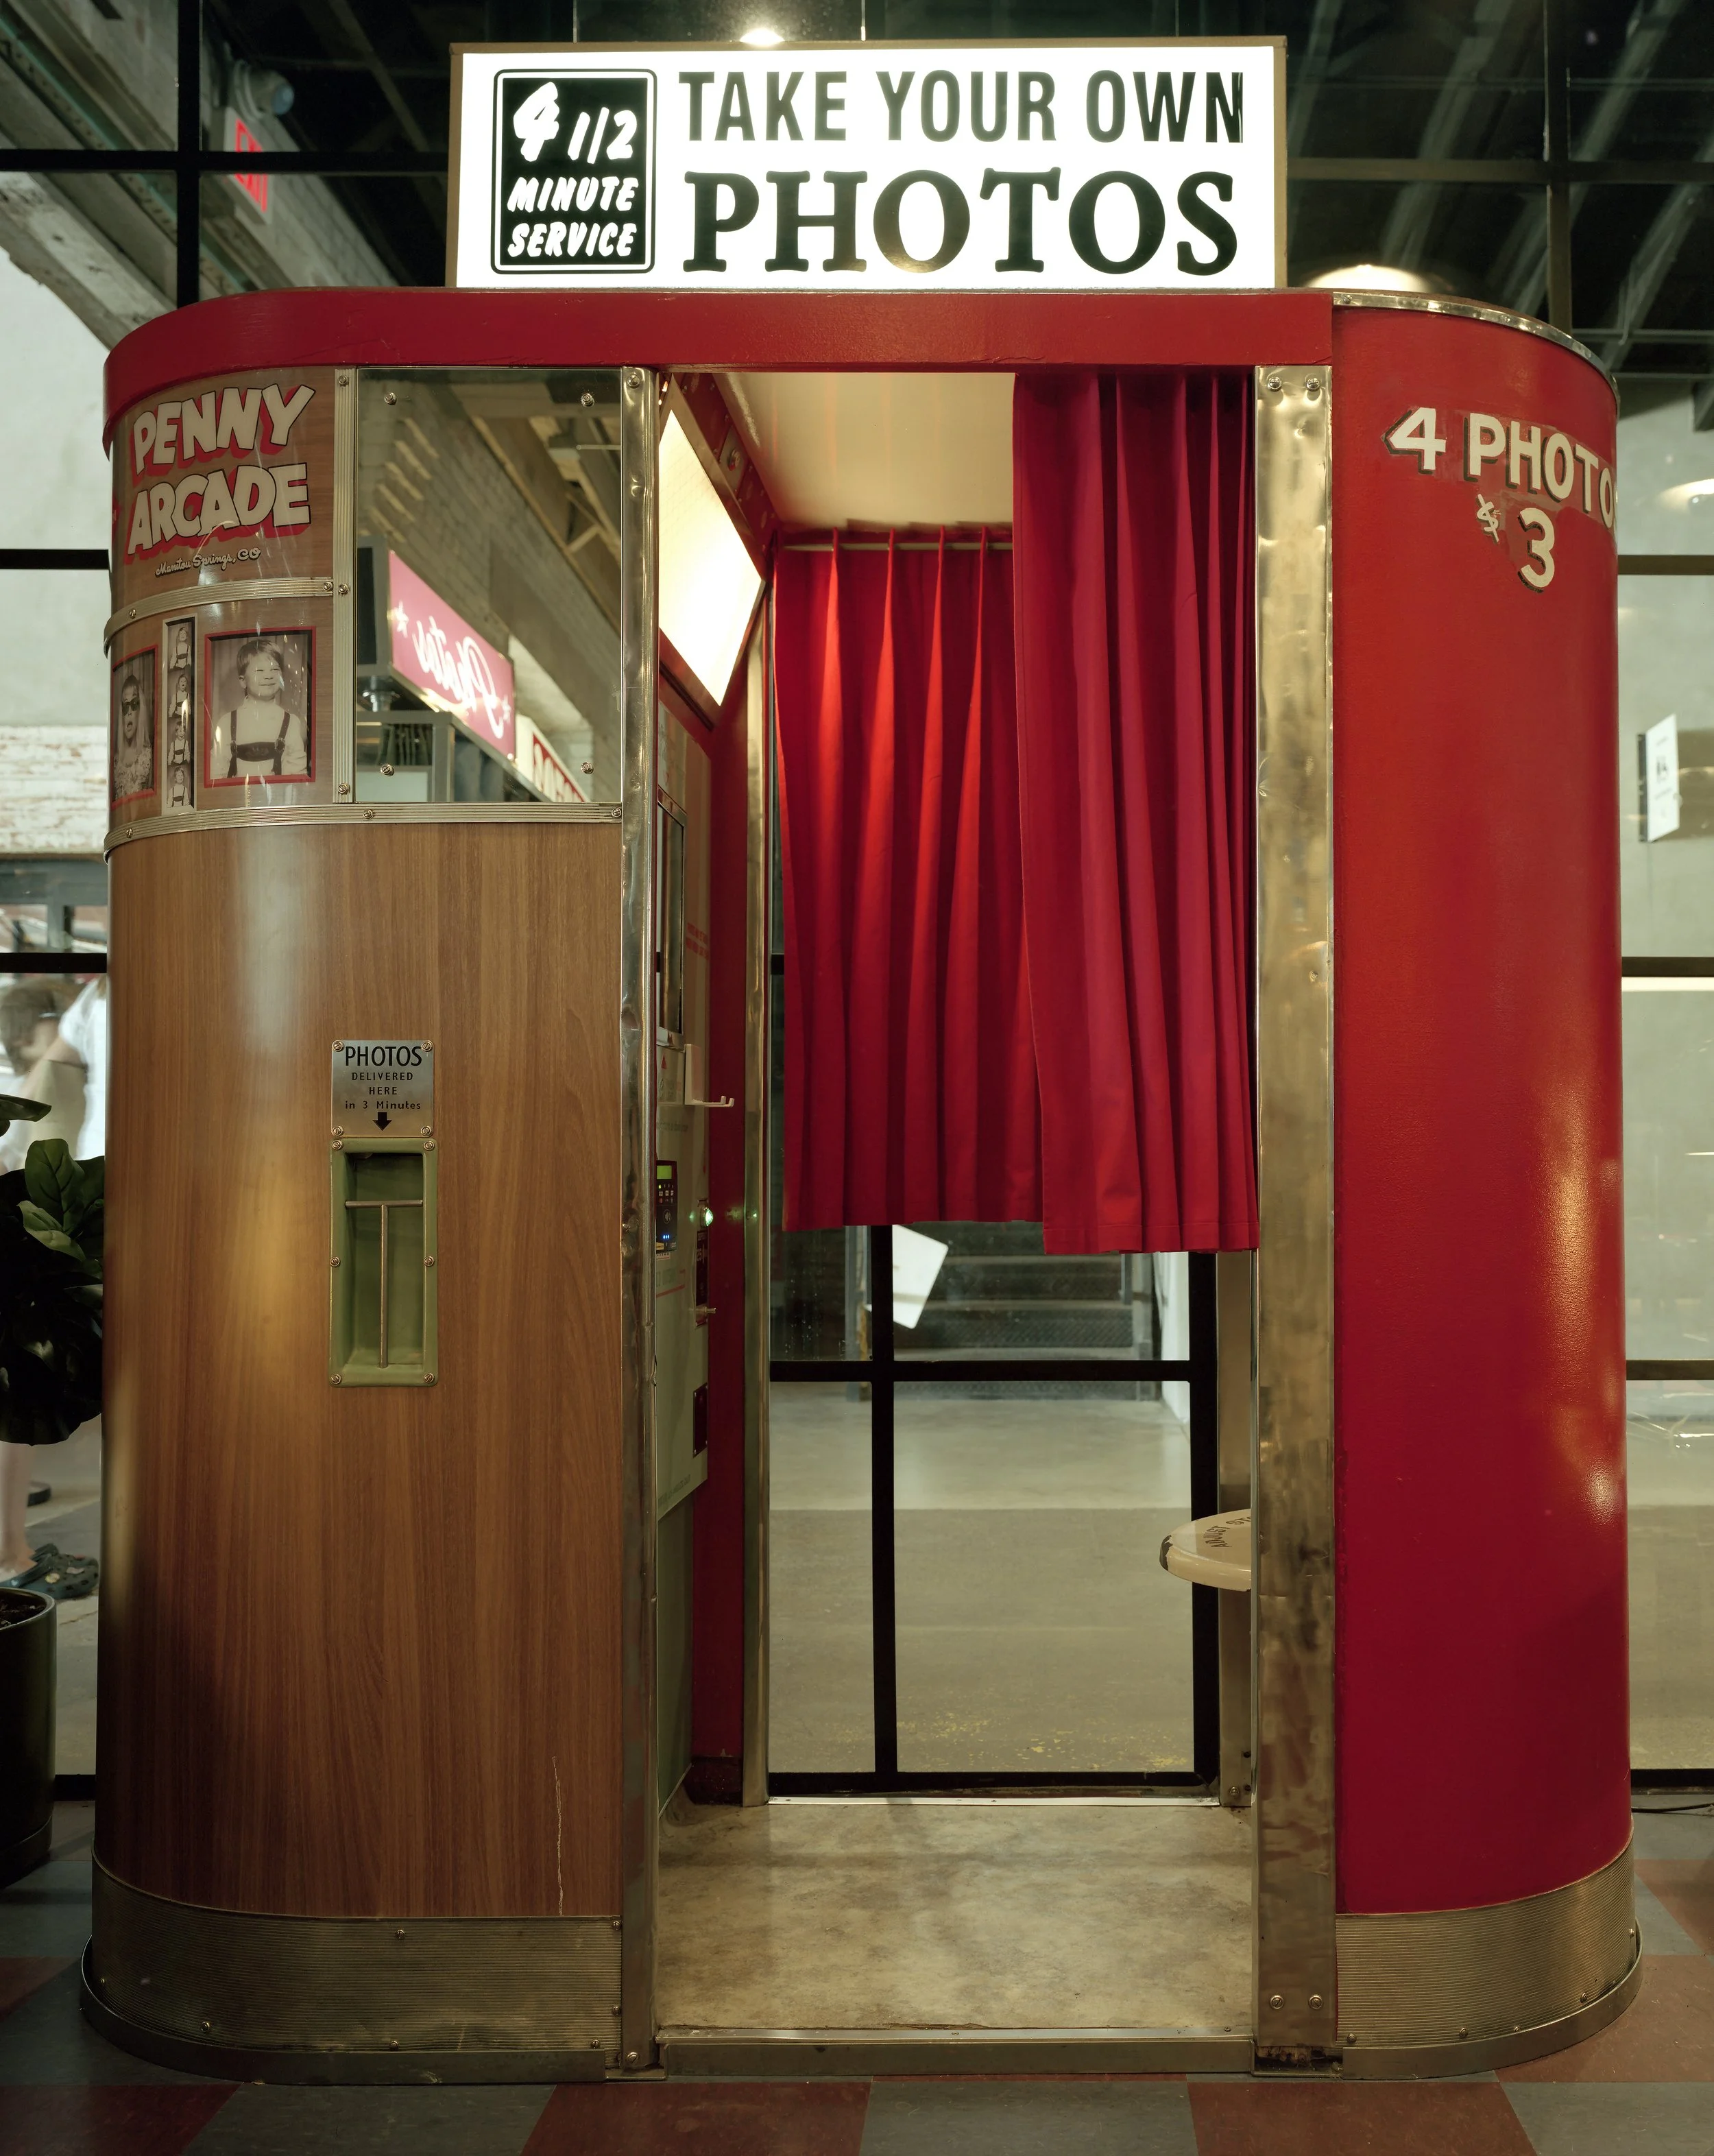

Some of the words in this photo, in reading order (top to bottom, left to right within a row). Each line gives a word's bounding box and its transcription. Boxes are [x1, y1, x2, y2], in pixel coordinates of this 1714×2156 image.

[512, 82, 559, 163] 4
[568, 107, 638, 165] 1/2
[679, 71, 847, 141] TAKE
[876, 69, 1057, 143] YOUR
[1085, 69, 1244, 143] OWN
[507, 176, 638, 213] MINUTE
[683, 167, 1238, 276] PHOTOS
[507, 222, 636, 259] SERVICE
[131, 383, 316, 481] PENNY
[1386, 407, 1447, 473] 4
[1466, 412, 1618, 531] PHOTO
[125, 462, 311, 558] ARCADE
[155, 558, 192, 577] Manitou
[192, 554, 237, 573] Springs,
[237, 547, 261, 560] CO
[346, 1046, 422, 1066] PHOTOS
[352, 1072, 413, 1081] DELIVERED
[369, 1086, 398, 1095] HERE
[345, 1101, 355, 1110] in
[363, 1101, 368, 1110] 3
[376, 1101, 421, 1110] Minutes
[1203, 1525, 1233, 1548] ADJUST
